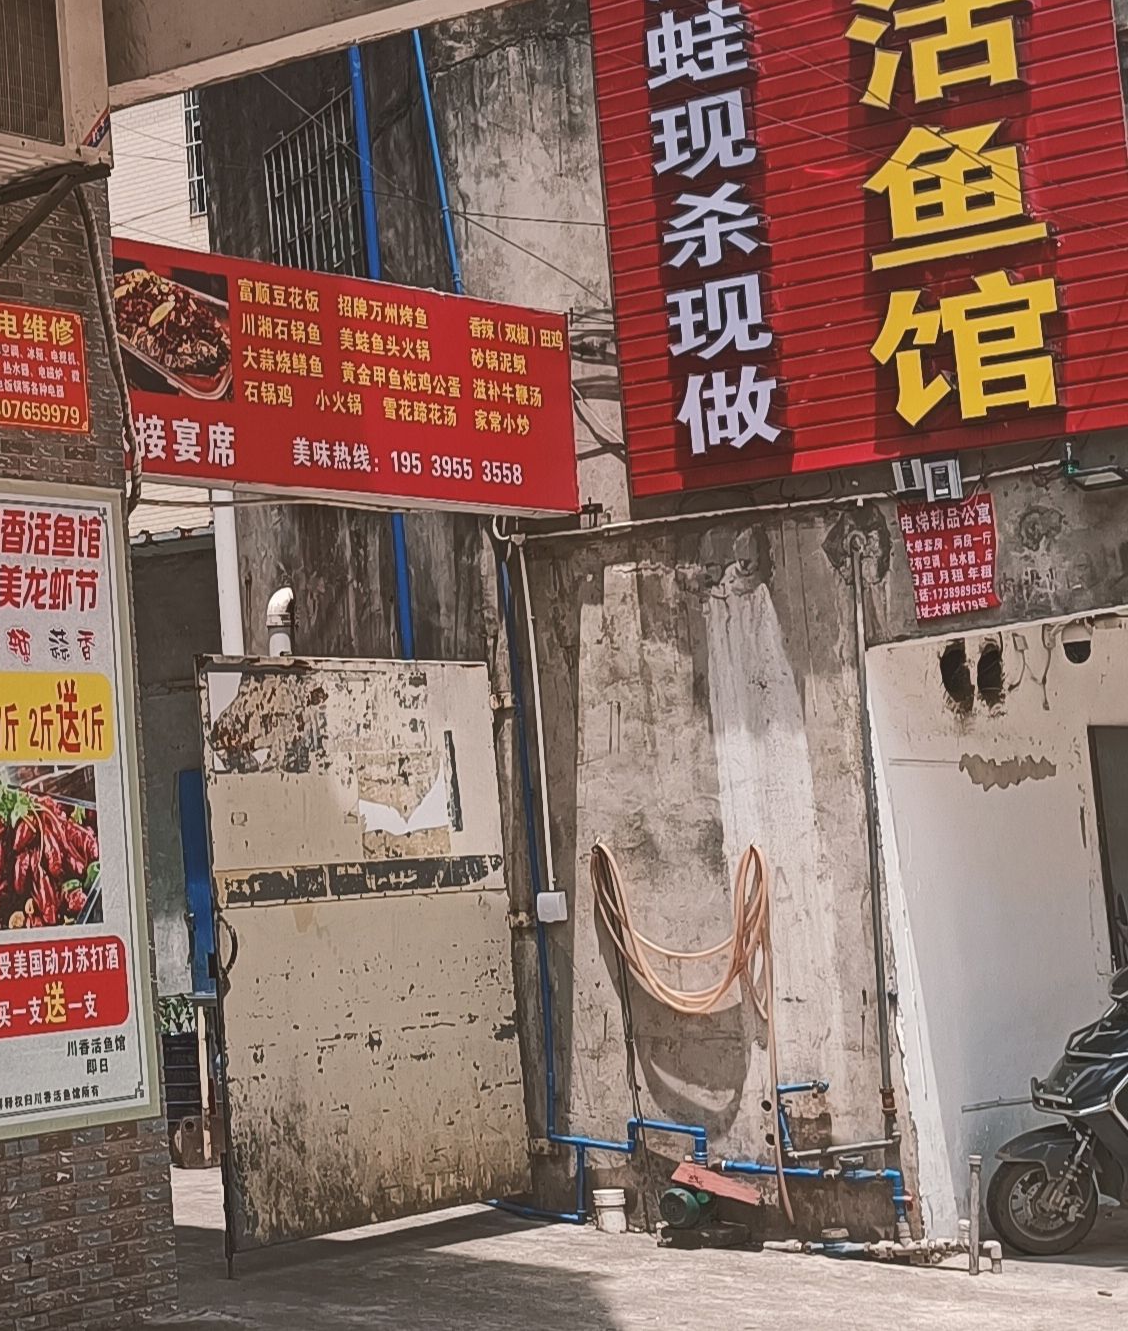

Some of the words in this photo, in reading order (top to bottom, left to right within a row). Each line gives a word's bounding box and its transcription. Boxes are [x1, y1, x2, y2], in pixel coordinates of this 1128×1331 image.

[237, 278, 320, 313] 富顺豆花饭
[337, 293, 429, 330] 招牌万州烤鱼
[241, 313, 322, 346] 川湘石锅鱼
[339, 327, 431, 362] 美蛙鱼头火锅
[242, 345, 324, 378] 大蒜烧鳝鱼
[470, 348, 527, 376] 砂锅泥鳅
[244, 381, 294, 408] 石锅鸡
[341, 361, 462, 399] 黄金甲鱼炖鸡公蛋
[473, 378, 542, 408] 滋补牛鞭汤
[315, 389, 363, 416] 小火锅
[474, 409, 530, 436] 家常小炒
[123, 414, 236, 467] 接宴席
[390, 450, 422, 475] 195
[431, 455, 473, 481] 3955
[482, 460, 524, 486] 3558
[29, 678, 104, 754] 2斤送1斤
[67, 1034, 126, 1057] 川香活鱼馆
[86, 1058, 109, 1076] 即日
